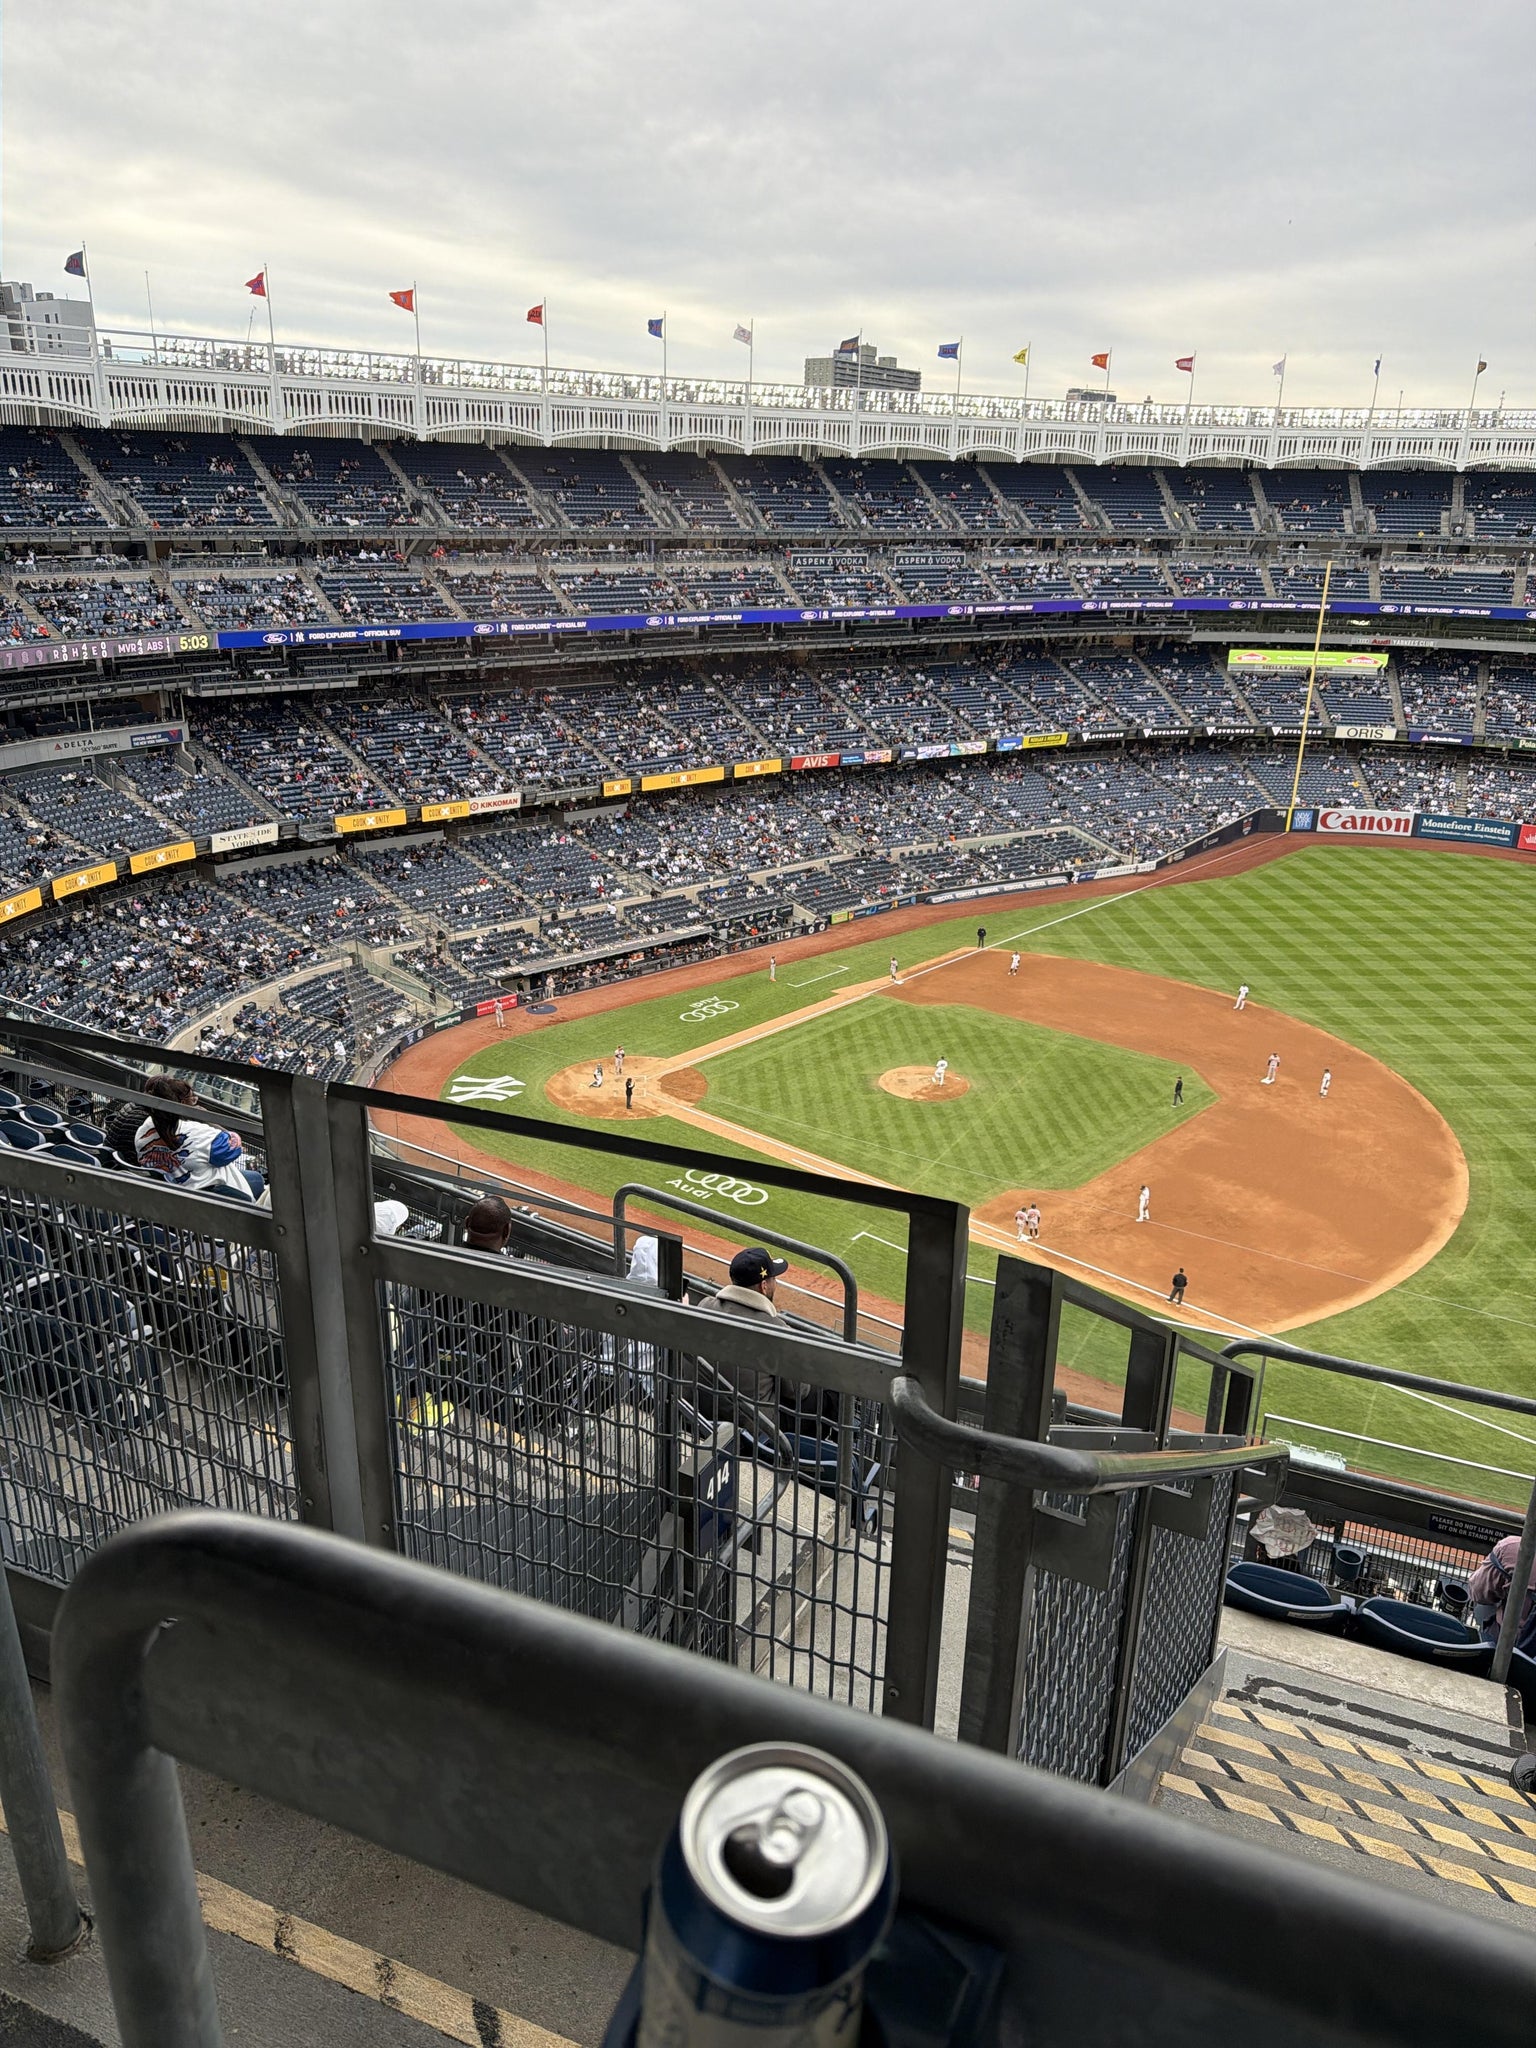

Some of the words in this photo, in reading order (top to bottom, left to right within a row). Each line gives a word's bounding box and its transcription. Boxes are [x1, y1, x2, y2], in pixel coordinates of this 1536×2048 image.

[795, 557, 825, 566] ASPEN
[836, 556, 864, 566] VODKA
[898, 556, 926, 564] ASPEN
[935, 556, 962, 565] VODKA
[61, 644, 67, 653] 3
[81, 643, 88, 651] 4
[100, 641, 107, 650] 0
[136, 638, 143, 647] 4
[180, 635, 209, 650] 5:03
[21, 651, 29, 664] 8
[35, 649, 43, 662] 9
[53, 649, 60, 660] R
[72, 647, 79, 658] H
[91, 646, 98, 656] E
[118, 643, 137, 654] MVR
[147, 641, 164, 651] ABS
[62, 653, 68, 661] 0
[82, 651, 89, 660] 2
[101, 649, 108, 658] 0
[137, 646, 144, 655] 3
[1346, 727, 1385, 739] ORIS
[63, 739, 94, 749] DELTA
[801, 756, 829, 768] AVIS
[480, 798, 519, 809] KIKKOMAN
[1320, 811, 1411, 833] Canon
[1421, 818, 1472, 831] Montefiore
[1474, 823, 1511, 836] Einstein
[219, 827, 272, 843] STATESIDE
[665, 1178, 713, 1200] Audi
[706, 1460, 730, 1501] 414
[1432, 1515, 1454, 1526] PLEASE
[1454, 1521, 1464, 1529] DO
[1464, 1523, 1477, 1532] NOT
[1478, 1527, 1494, 1536] LEAN
[1438, 1523, 1448, 1531] SIT
[1448, 1526, 1458, 1534] ON
[1459, 1529, 1467, 1537] OR
[1468, 1530, 1488, 1541] STAND
